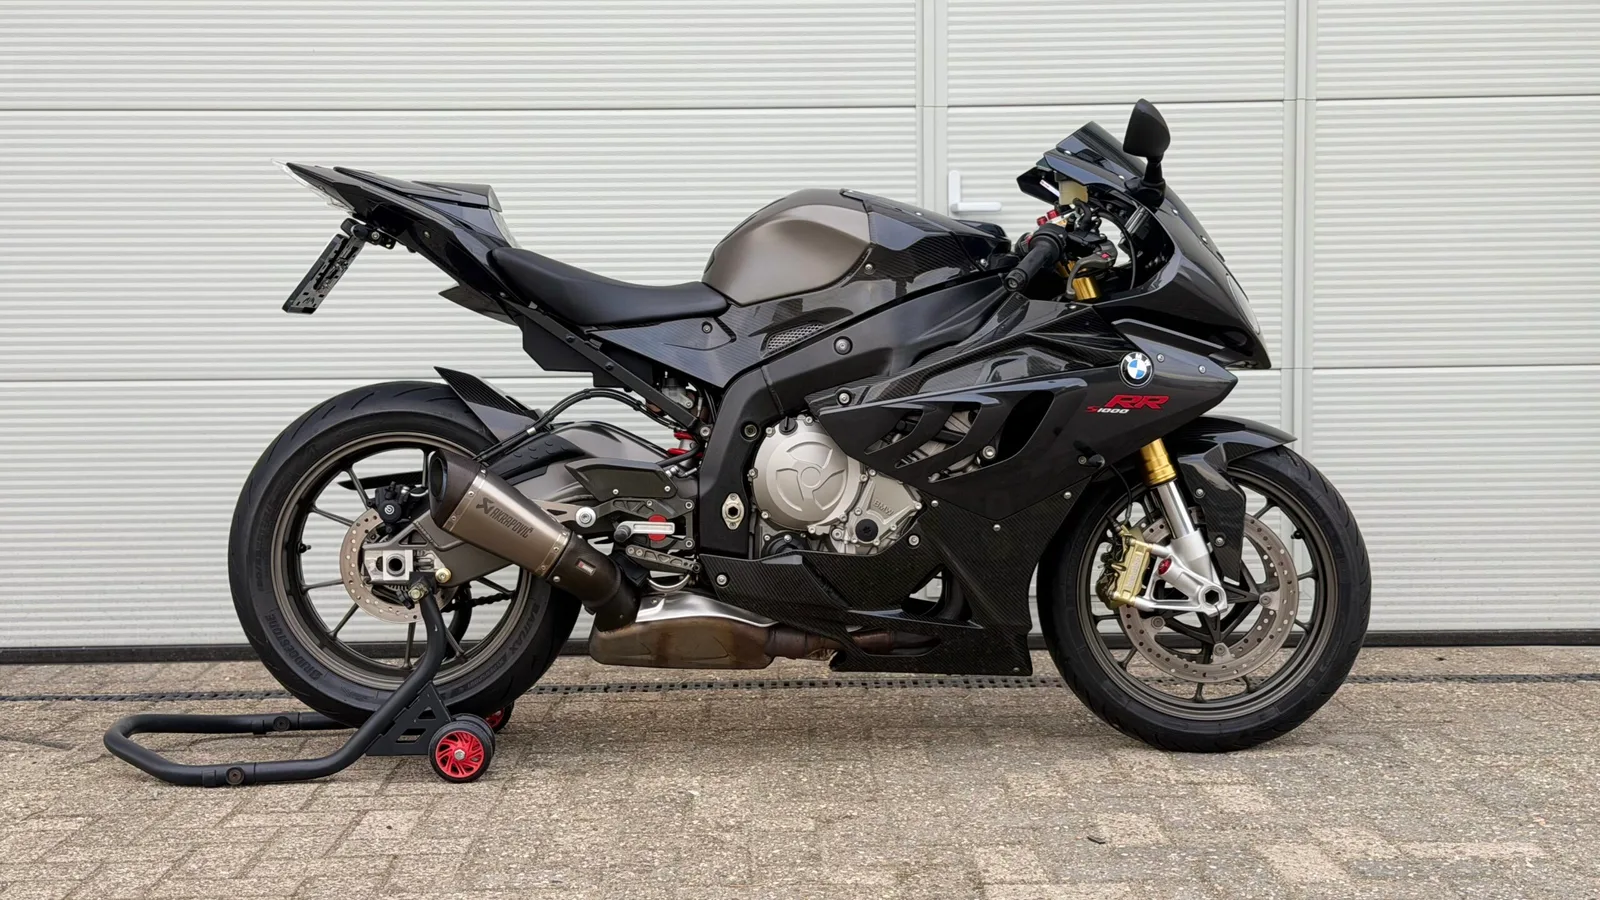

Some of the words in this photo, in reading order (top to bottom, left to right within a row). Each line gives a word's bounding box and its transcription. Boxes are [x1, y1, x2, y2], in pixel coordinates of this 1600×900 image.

[1104, 394, 1170, 410] RR
[874, 499, 895, 516] BMW
[265, 613, 324, 681] BRIDGESTONE
